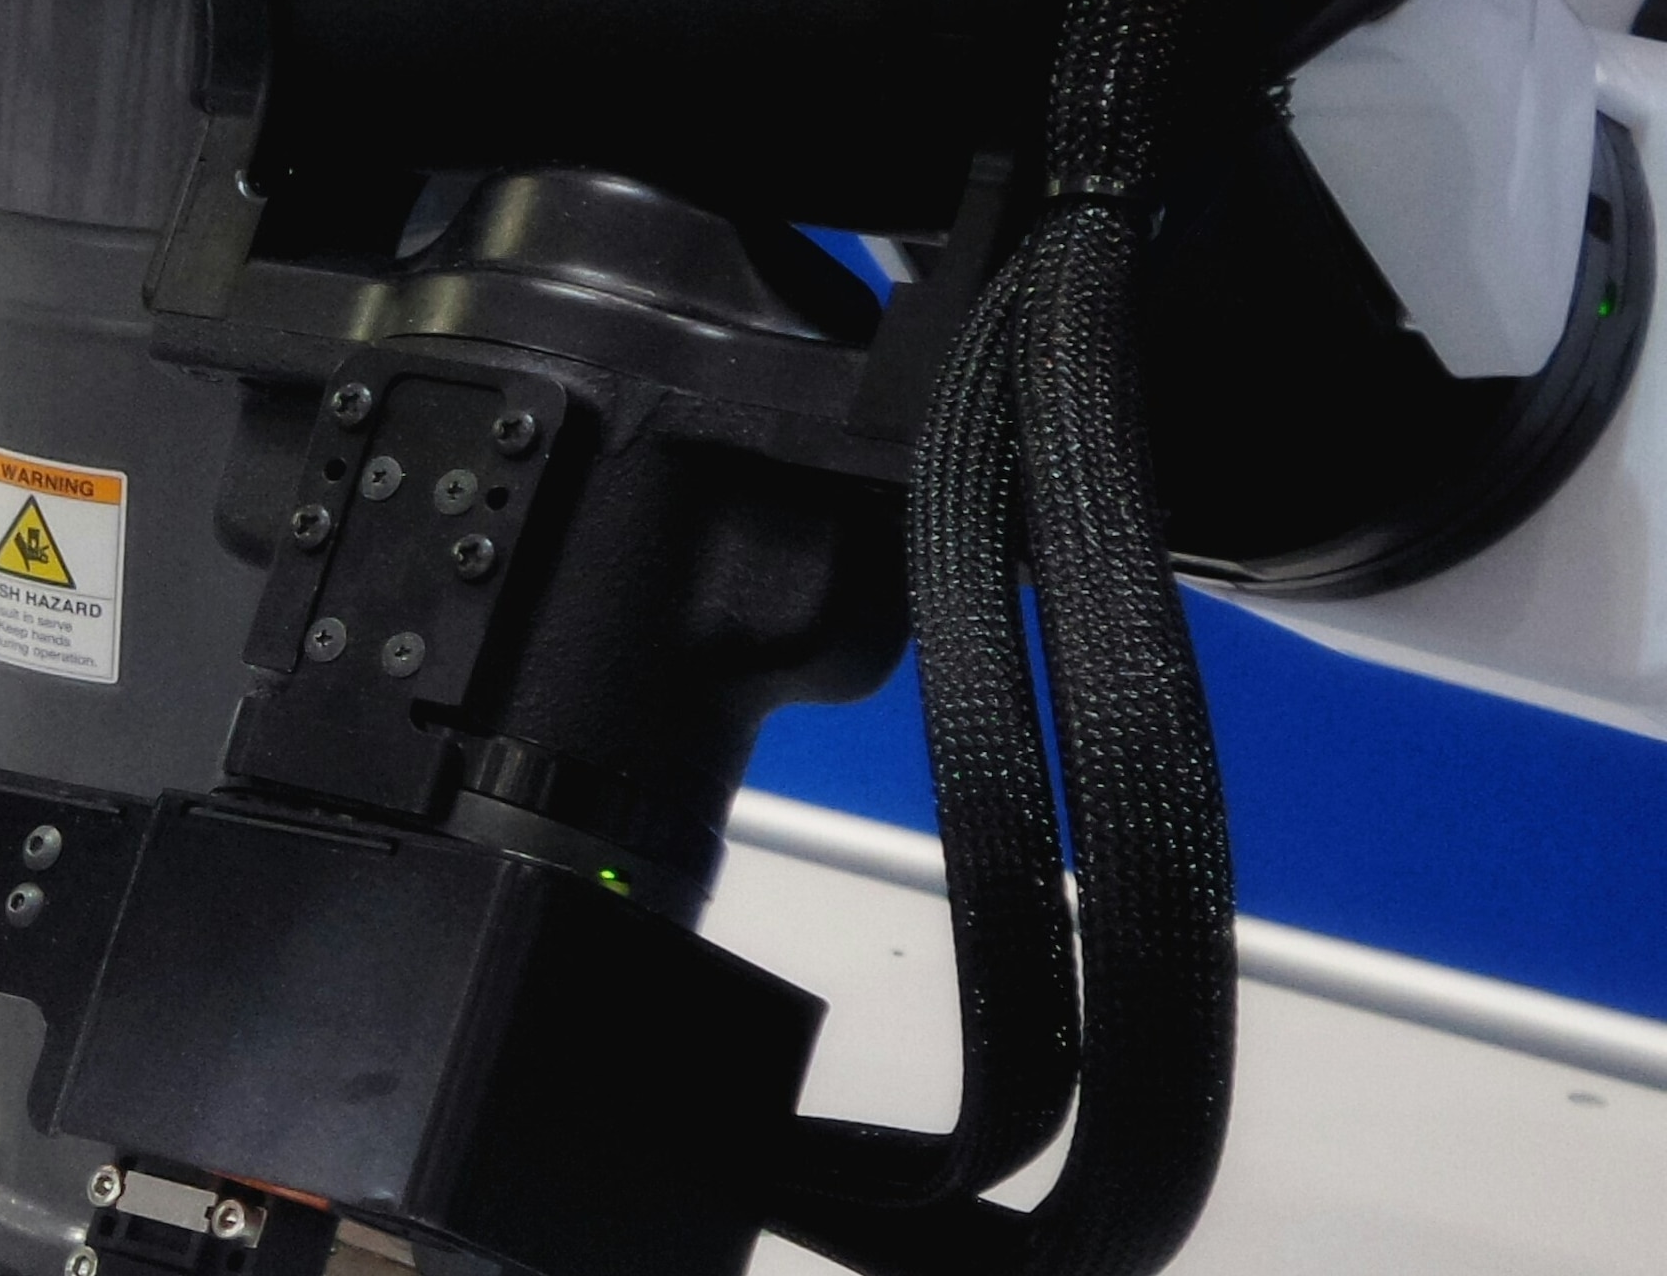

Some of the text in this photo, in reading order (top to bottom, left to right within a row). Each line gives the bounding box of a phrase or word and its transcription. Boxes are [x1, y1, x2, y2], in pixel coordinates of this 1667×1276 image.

[1, 462, 95, 498] WARNING
[23, 610, 34, 624] in
[25, 590, 103, 618] HAZARD
